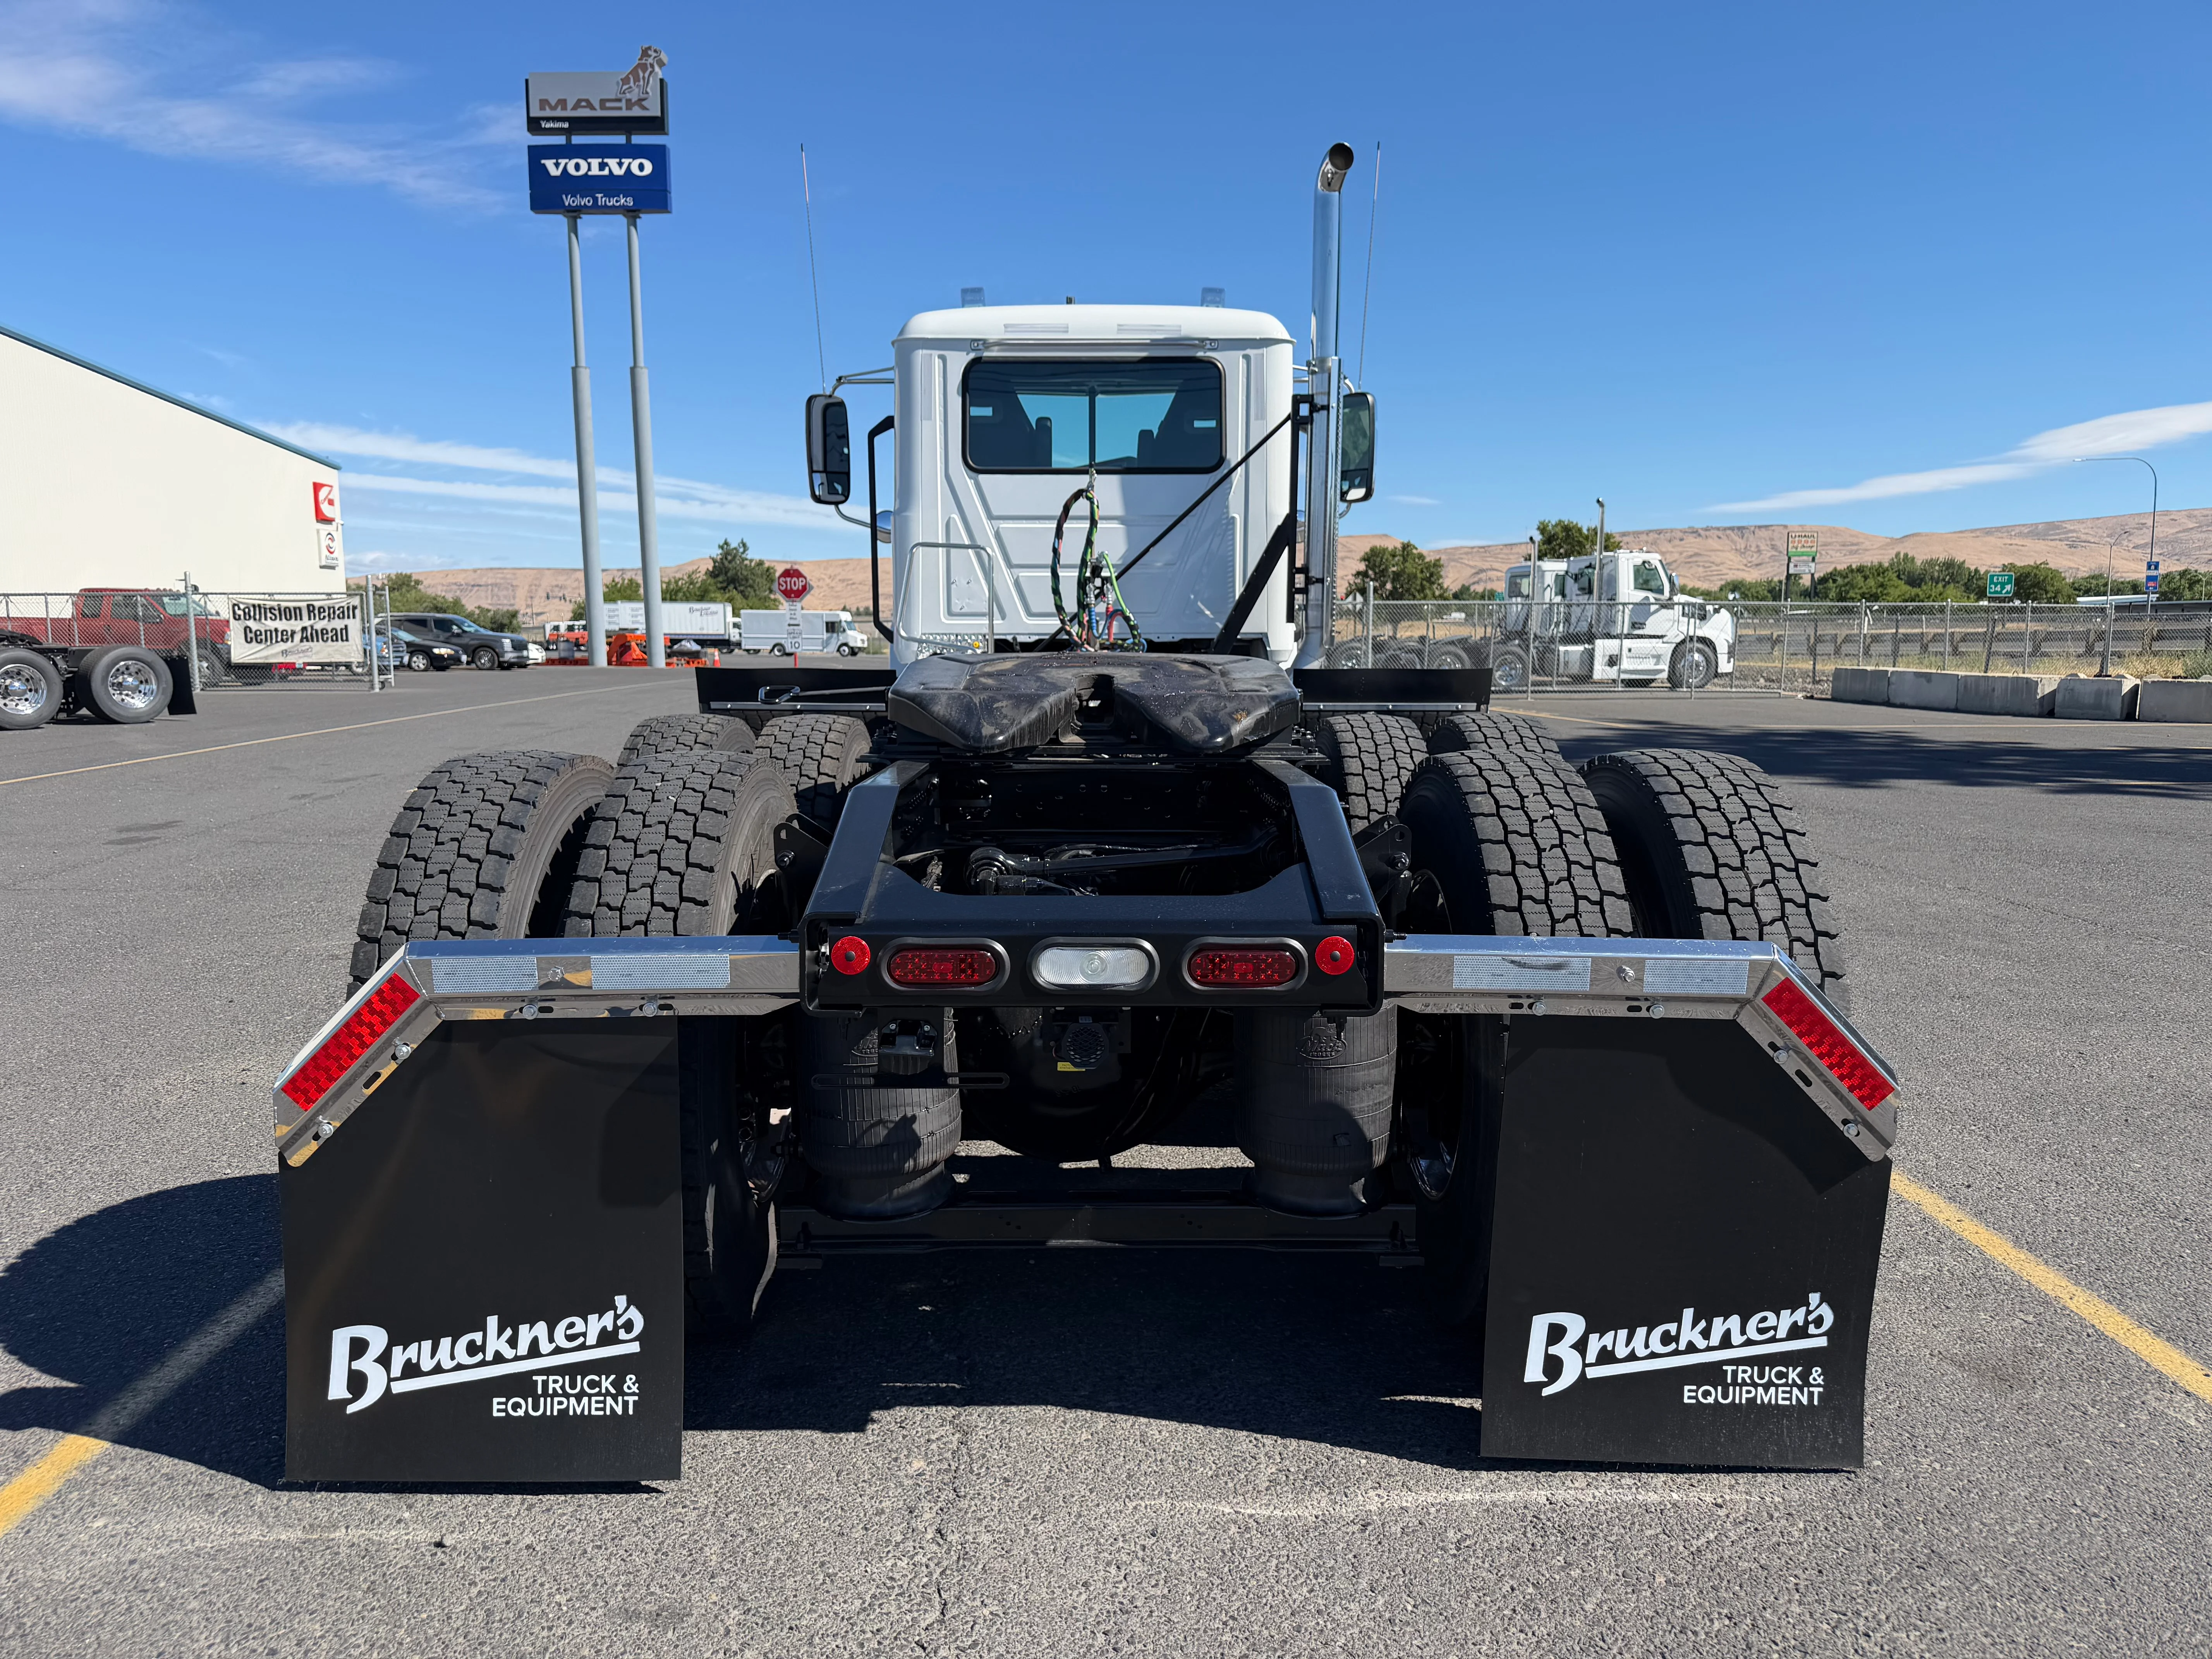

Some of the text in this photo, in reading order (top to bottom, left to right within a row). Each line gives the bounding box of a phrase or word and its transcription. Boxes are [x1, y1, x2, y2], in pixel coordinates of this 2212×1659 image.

[539, 98, 650, 111] MACK
[539, 120, 569, 128] Yakima
[541, 158, 653, 177] VOLVO
[562, 193, 634, 206] Volvo Trucks
[779, 577, 806, 591] STOP
[1989, 584, 2001, 592] 34
[232, 602, 358, 622] Collision Repair
[244, 624, 349, 644] Center Ahead
[790, 641, 800, 649] 10
[1523, 1292, 1834, 1396] Bruckner's
[327, 1295, 644, 1414] Bruckner's
[532, 1374, 640, 1394] TRUCK &
[1723, 1365, 1825, 1384] TRUCK &
[1683, 1386, 1824, 1405] EQUIPMENT
[492, 1396, 639, 1417] EQUIPMENT
